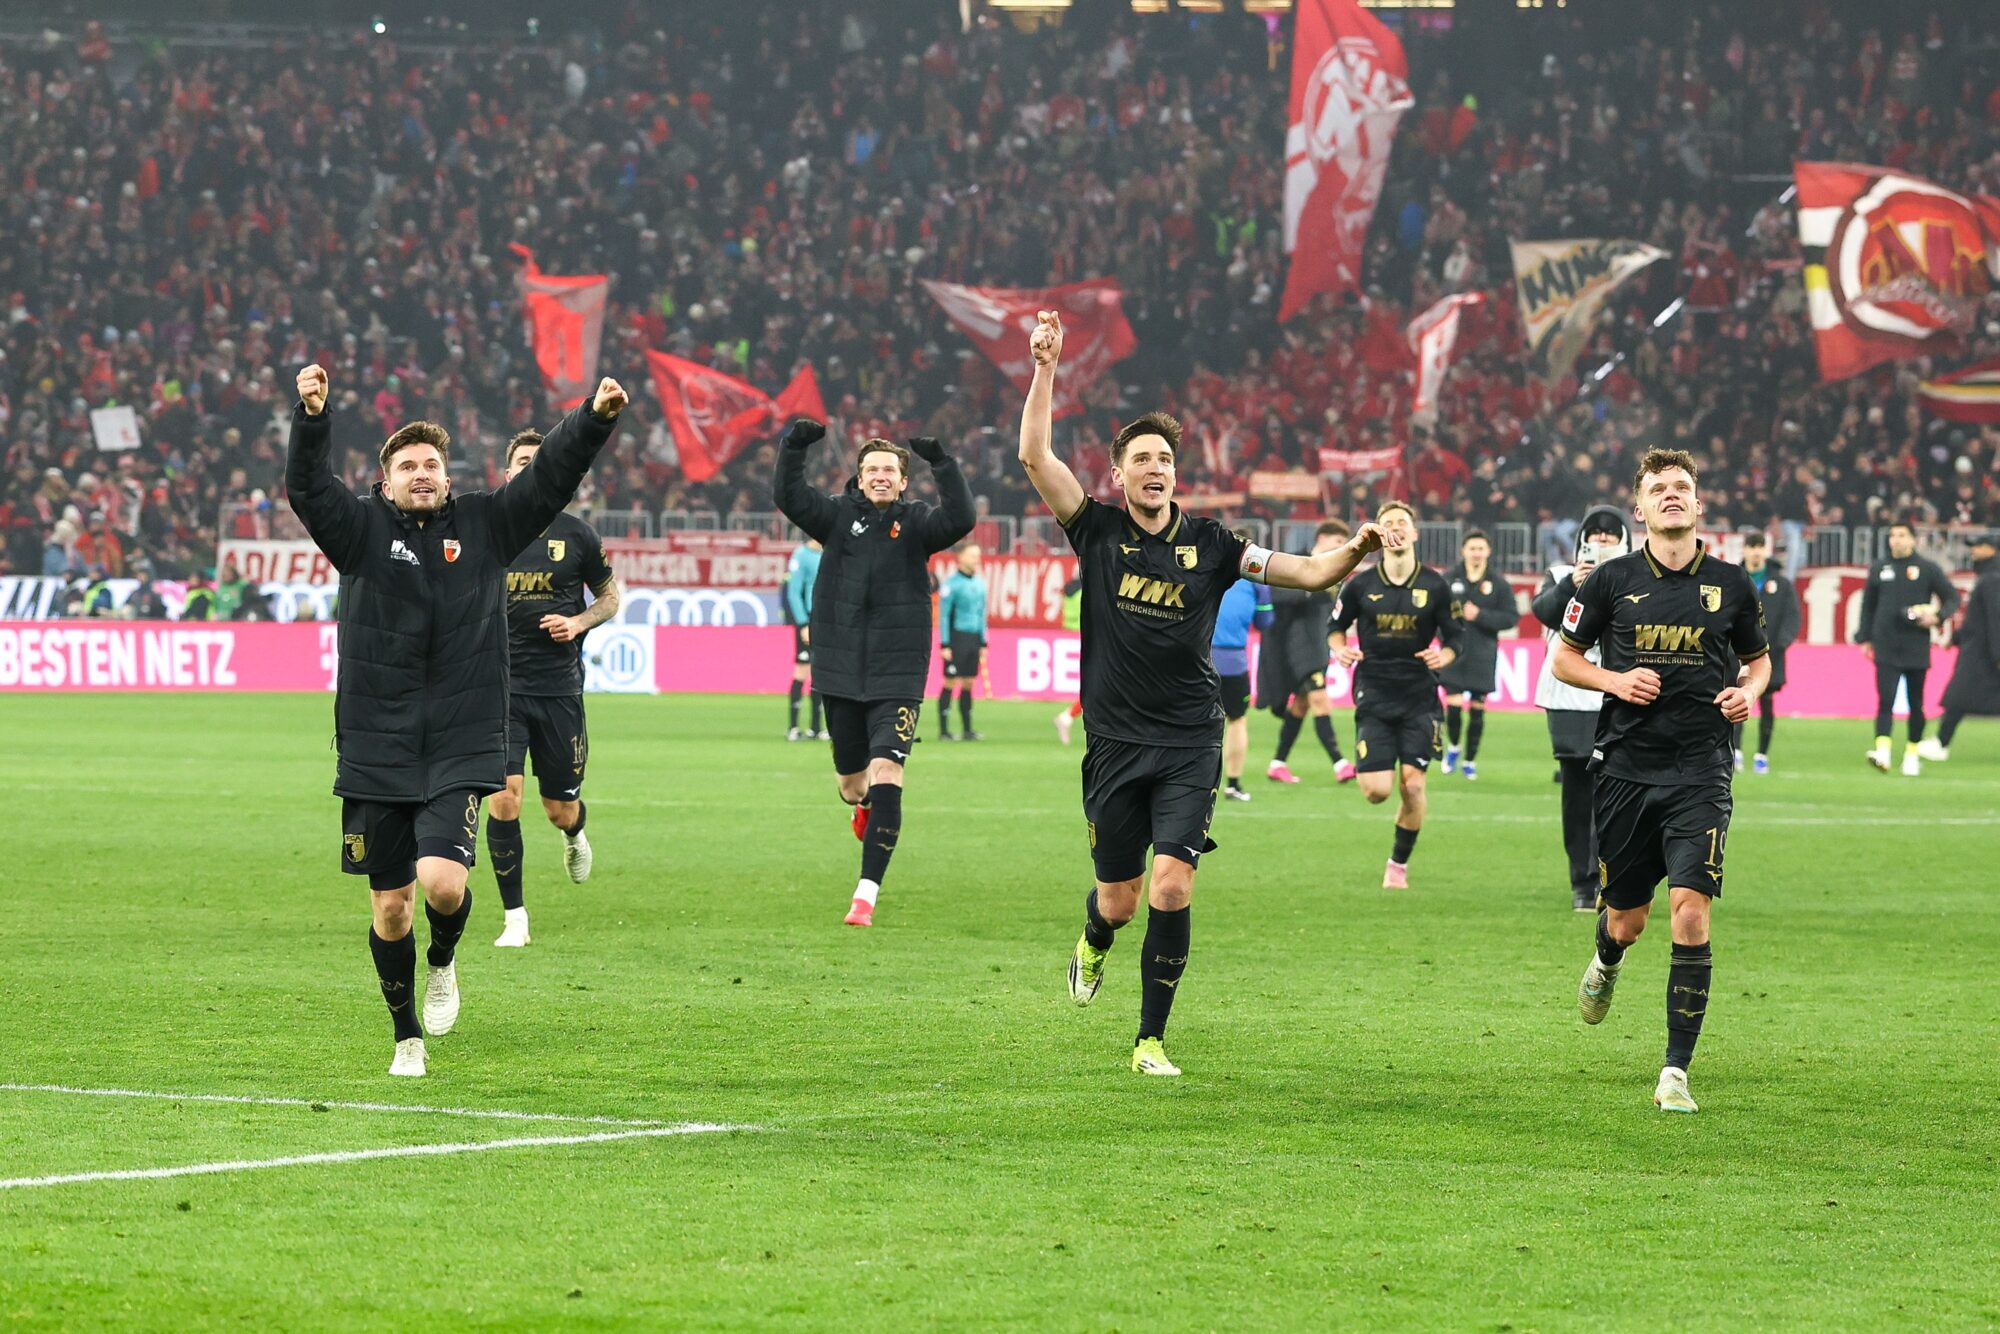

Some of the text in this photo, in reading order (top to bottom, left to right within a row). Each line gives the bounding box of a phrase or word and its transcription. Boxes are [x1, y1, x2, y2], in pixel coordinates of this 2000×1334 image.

[1118, 572, 1186, 608] WWK
[1702, 586, 1719, 594] FCA
[1116, 601, 1184, 621] VERSICHERUNGEN
[1635, 624, 1705, 652] WWK
[0, 627, 237, 686] BESTEN NETZ
[1635, 656, 1704, 666] VERSICHERUNGEN
[895, 707, 917, 735] 38
[465, 794, 478, 825] 8
